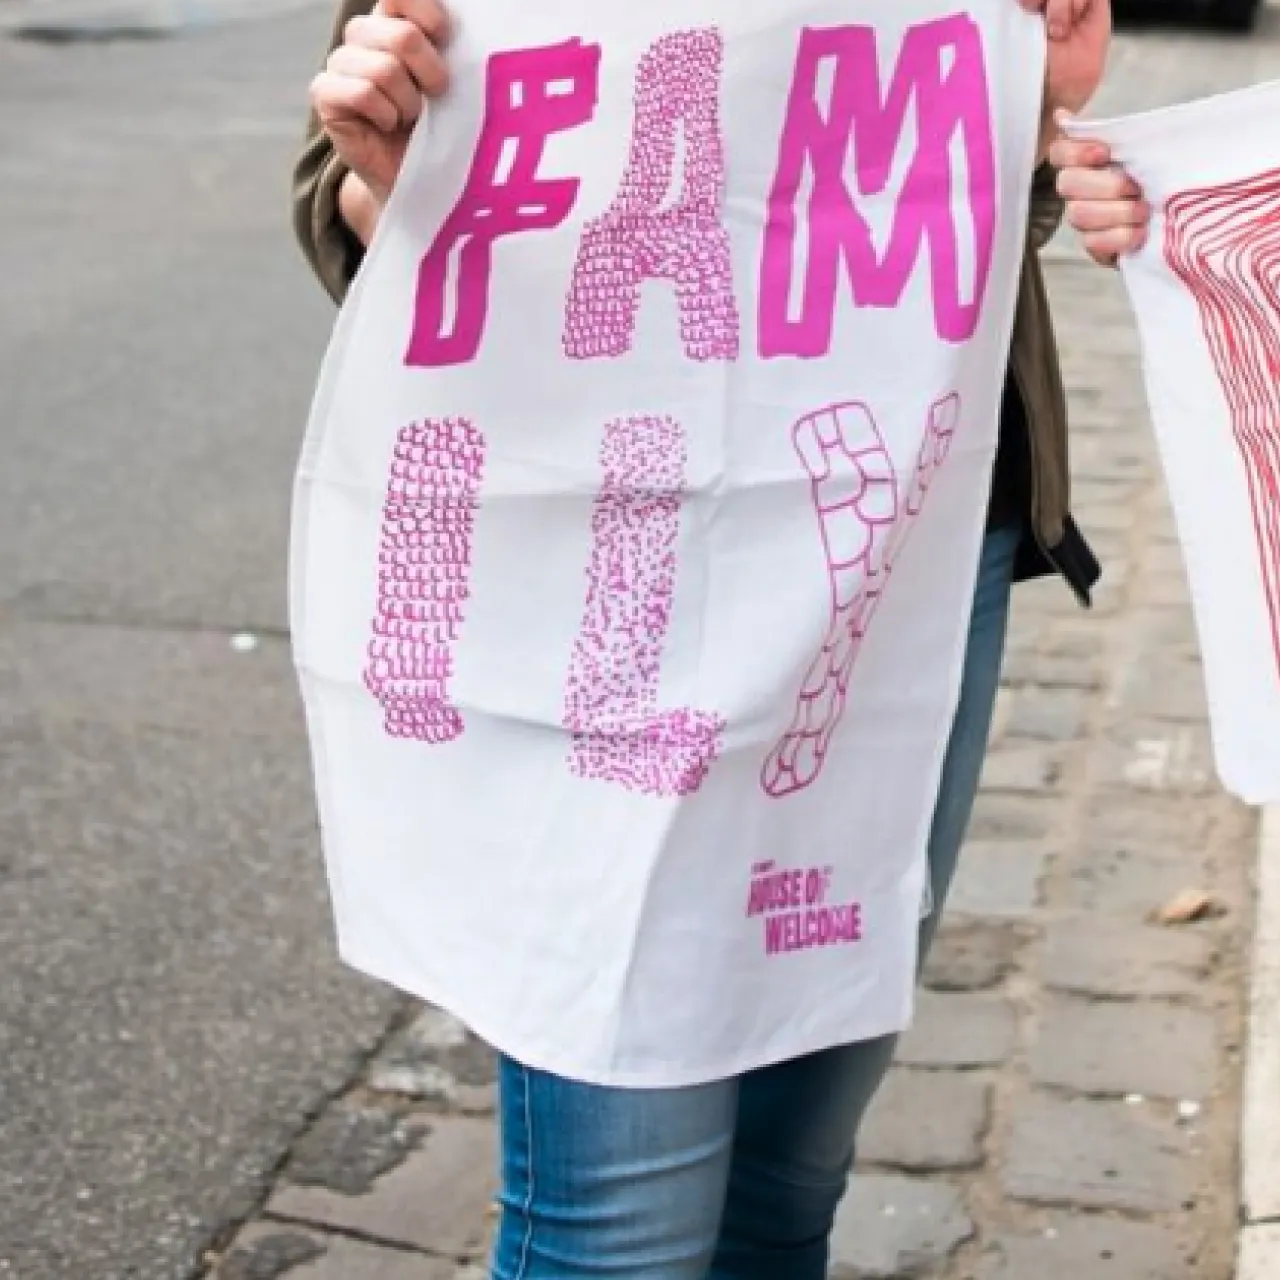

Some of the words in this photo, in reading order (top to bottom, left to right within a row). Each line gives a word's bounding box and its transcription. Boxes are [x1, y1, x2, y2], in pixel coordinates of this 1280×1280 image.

[404, 12, 997, 367] FAM
[362, 391, 959, 798] ILY
[766, 903, 862, 955] WELCOME
